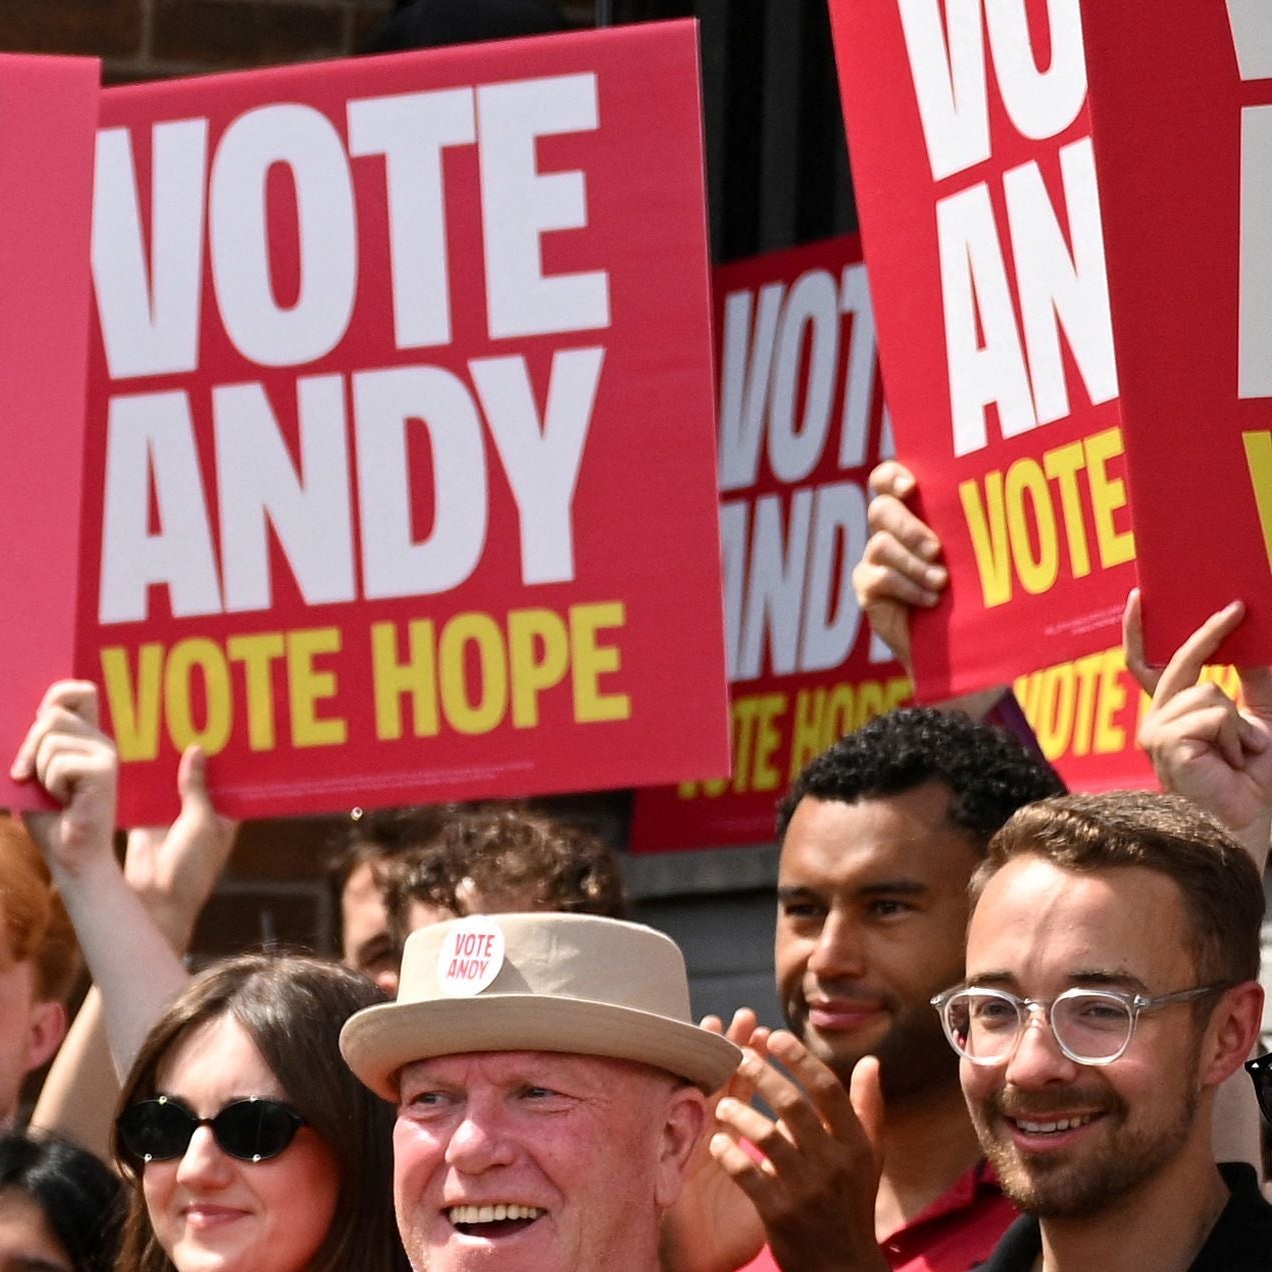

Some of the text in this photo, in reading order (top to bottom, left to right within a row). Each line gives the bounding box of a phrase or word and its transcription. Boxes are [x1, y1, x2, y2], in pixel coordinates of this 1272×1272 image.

[91, 72, 611, 380] VOTE
[936, 136, 1119, 458] AN
[719, 262, 897, 493] VOT
[98, 347, 606, 625] ANDY
[958, 427, 1136, 608] VOTE
[100, 602, 631, 763] VOTE HOPE
[445, 958, 489, 980] ANDY
[455, 933, 496, 957] VOTE
